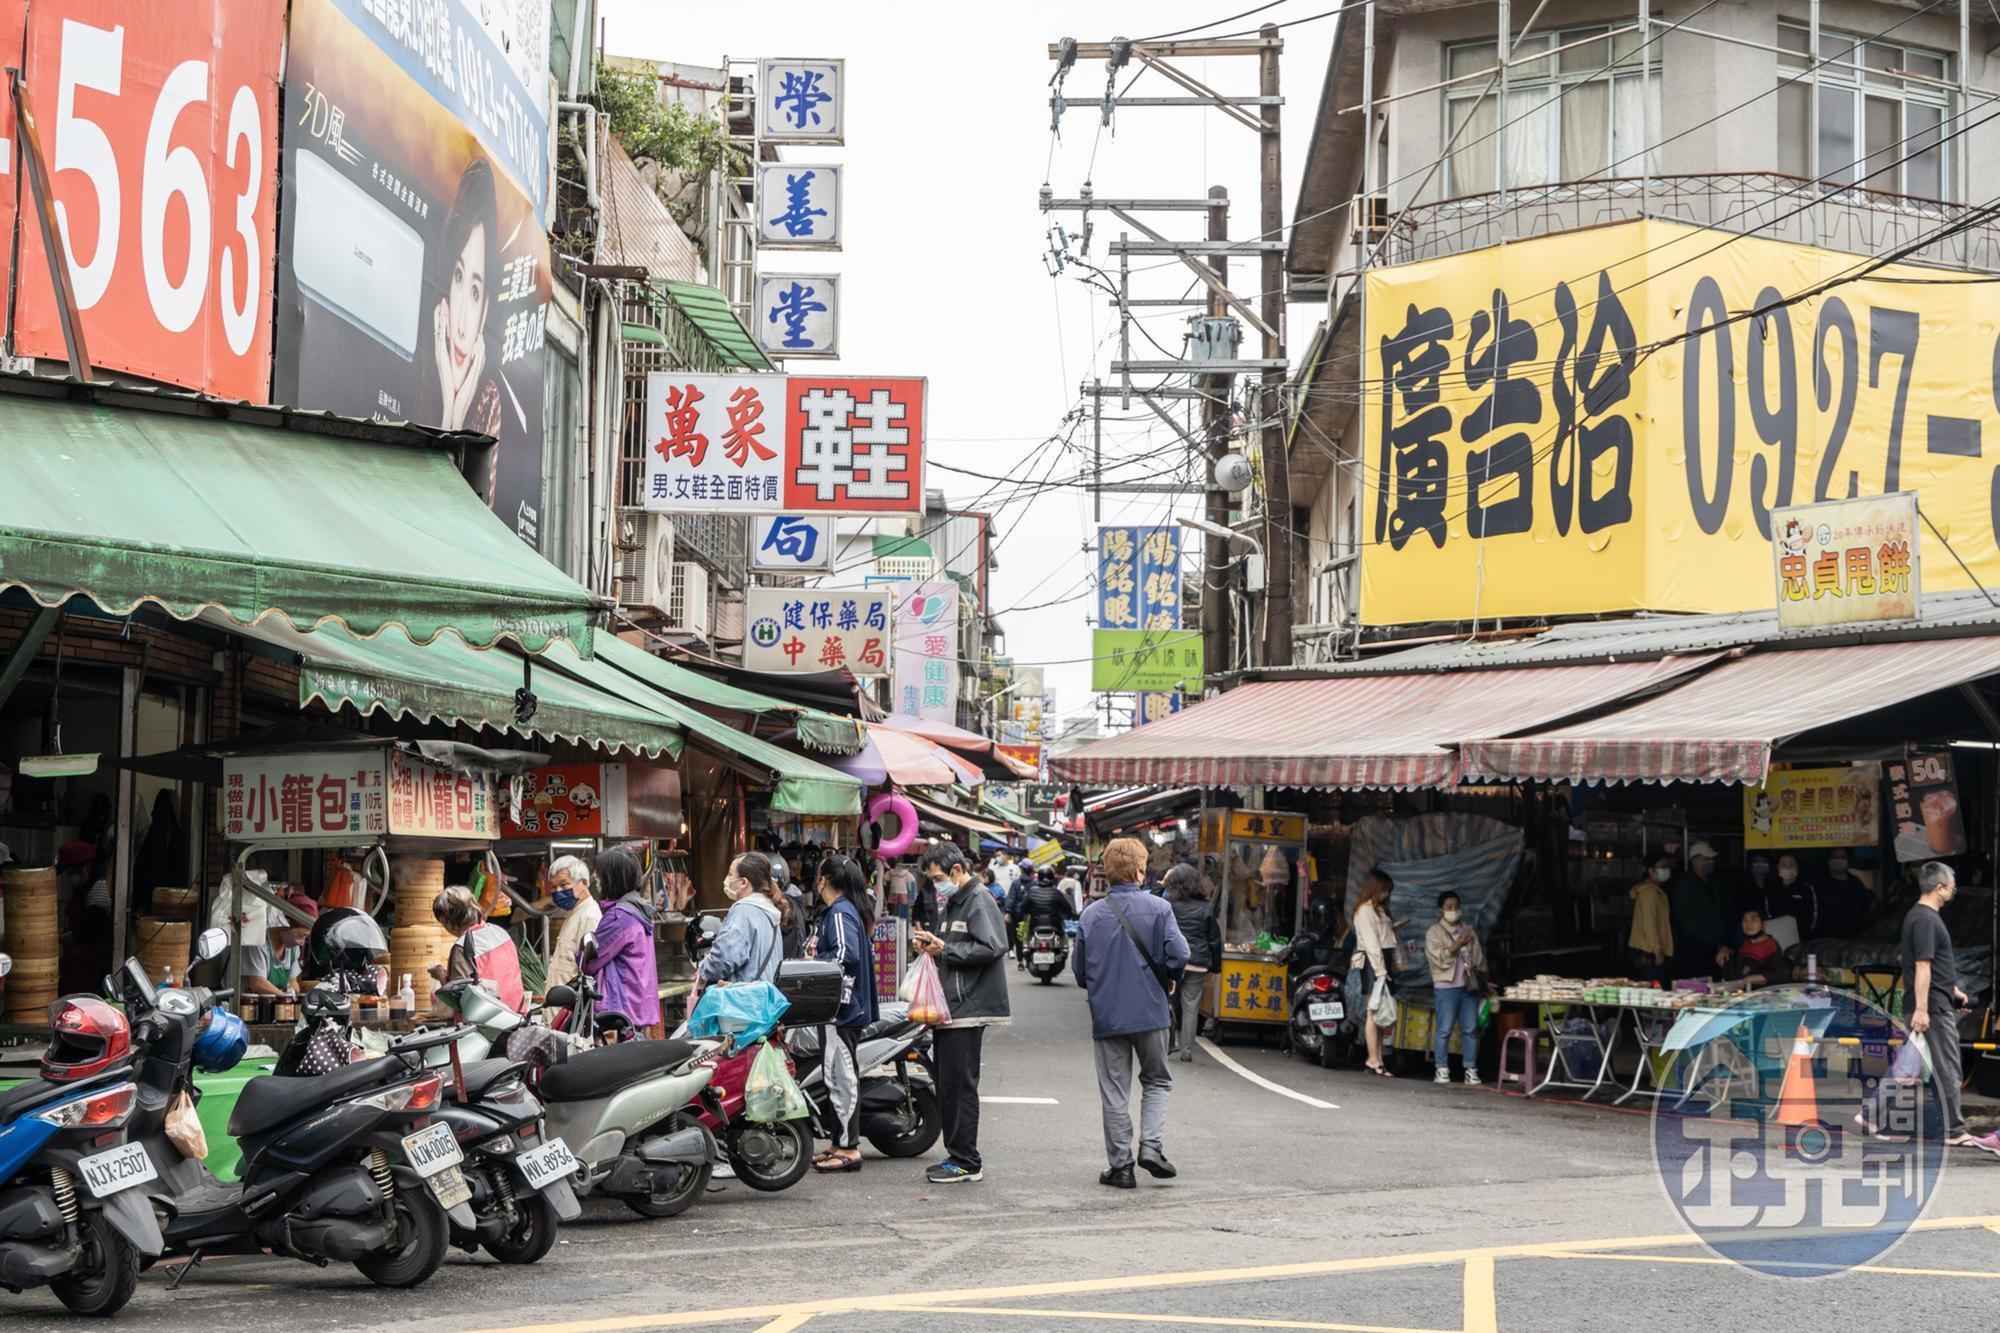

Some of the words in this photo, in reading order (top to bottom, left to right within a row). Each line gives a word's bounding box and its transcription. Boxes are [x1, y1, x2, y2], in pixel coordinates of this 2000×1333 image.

[299, 81, 346, 155] 3D風
[654, 383, 778, 468] 萬象
[1375, 269, 1639, 552] 廣告洽
[1682, 275, 2000, 551] 0927-
[795, 387, 911, 502] 鞋
[761, 516, 819, 562] 局
[1780, 540, 1912, 602] 忠貞甩餅
[782, 601, 887, 631] 健保藥局
[782, 635, 885, 669] 中藥局
[923, 635, 949, 707] 愛健康
[226, 773, 244, 834] 現做祖傳
[246, 772, 349, 833] 小籠包
[364, 792, 383, 810] 10元
[365, 813, 383, 831] 10元
[413, 767, 475, 832] 小籠包
